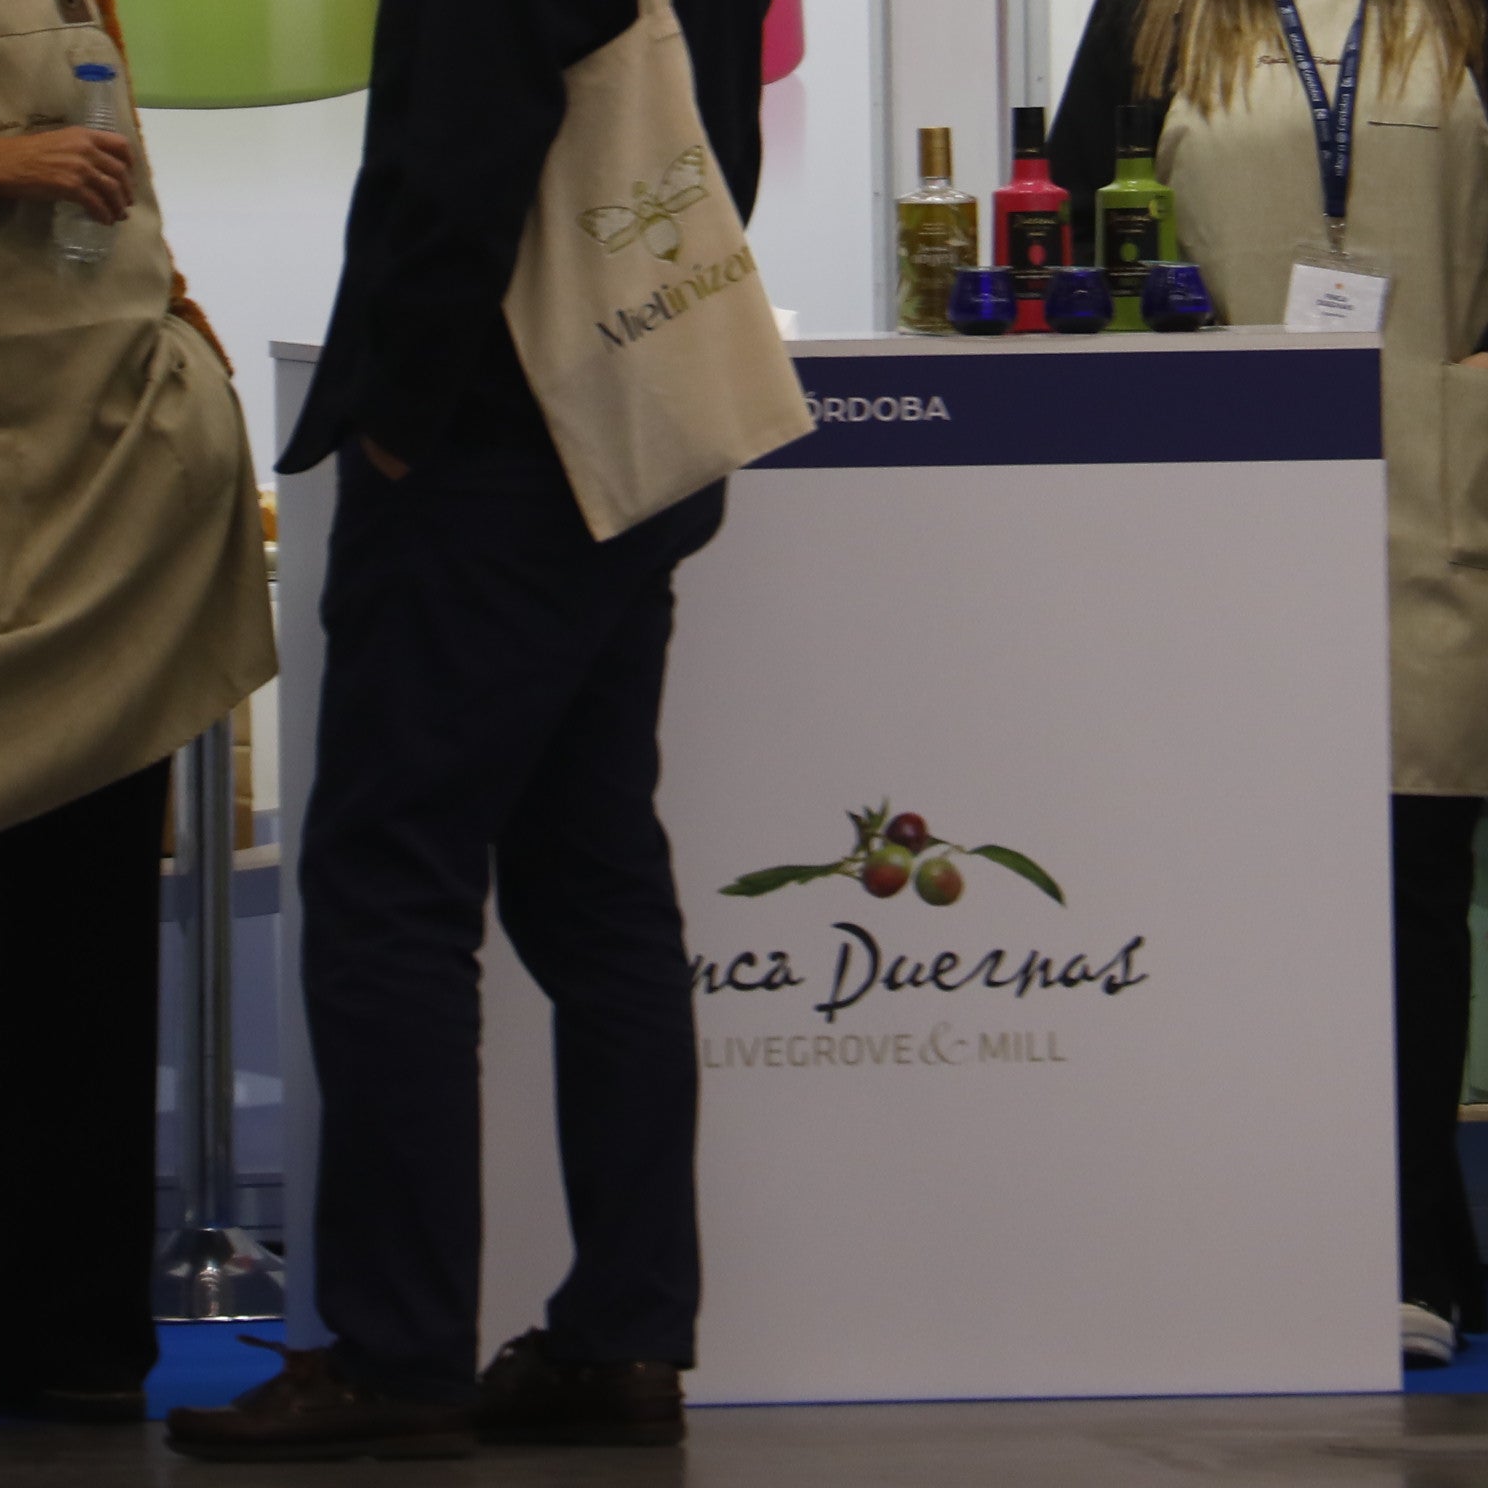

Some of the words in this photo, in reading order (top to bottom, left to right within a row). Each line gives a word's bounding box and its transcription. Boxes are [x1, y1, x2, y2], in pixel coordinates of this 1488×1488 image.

[803, 390, 953, 423] ÓRDOBA
[689, 947, 808, 996] nca
[814, 921, 1150, 1025] Duernas
[702, 1032, 912, 1070] LIVEGROVE
[977, 1029, 1068, 1065] MILL
